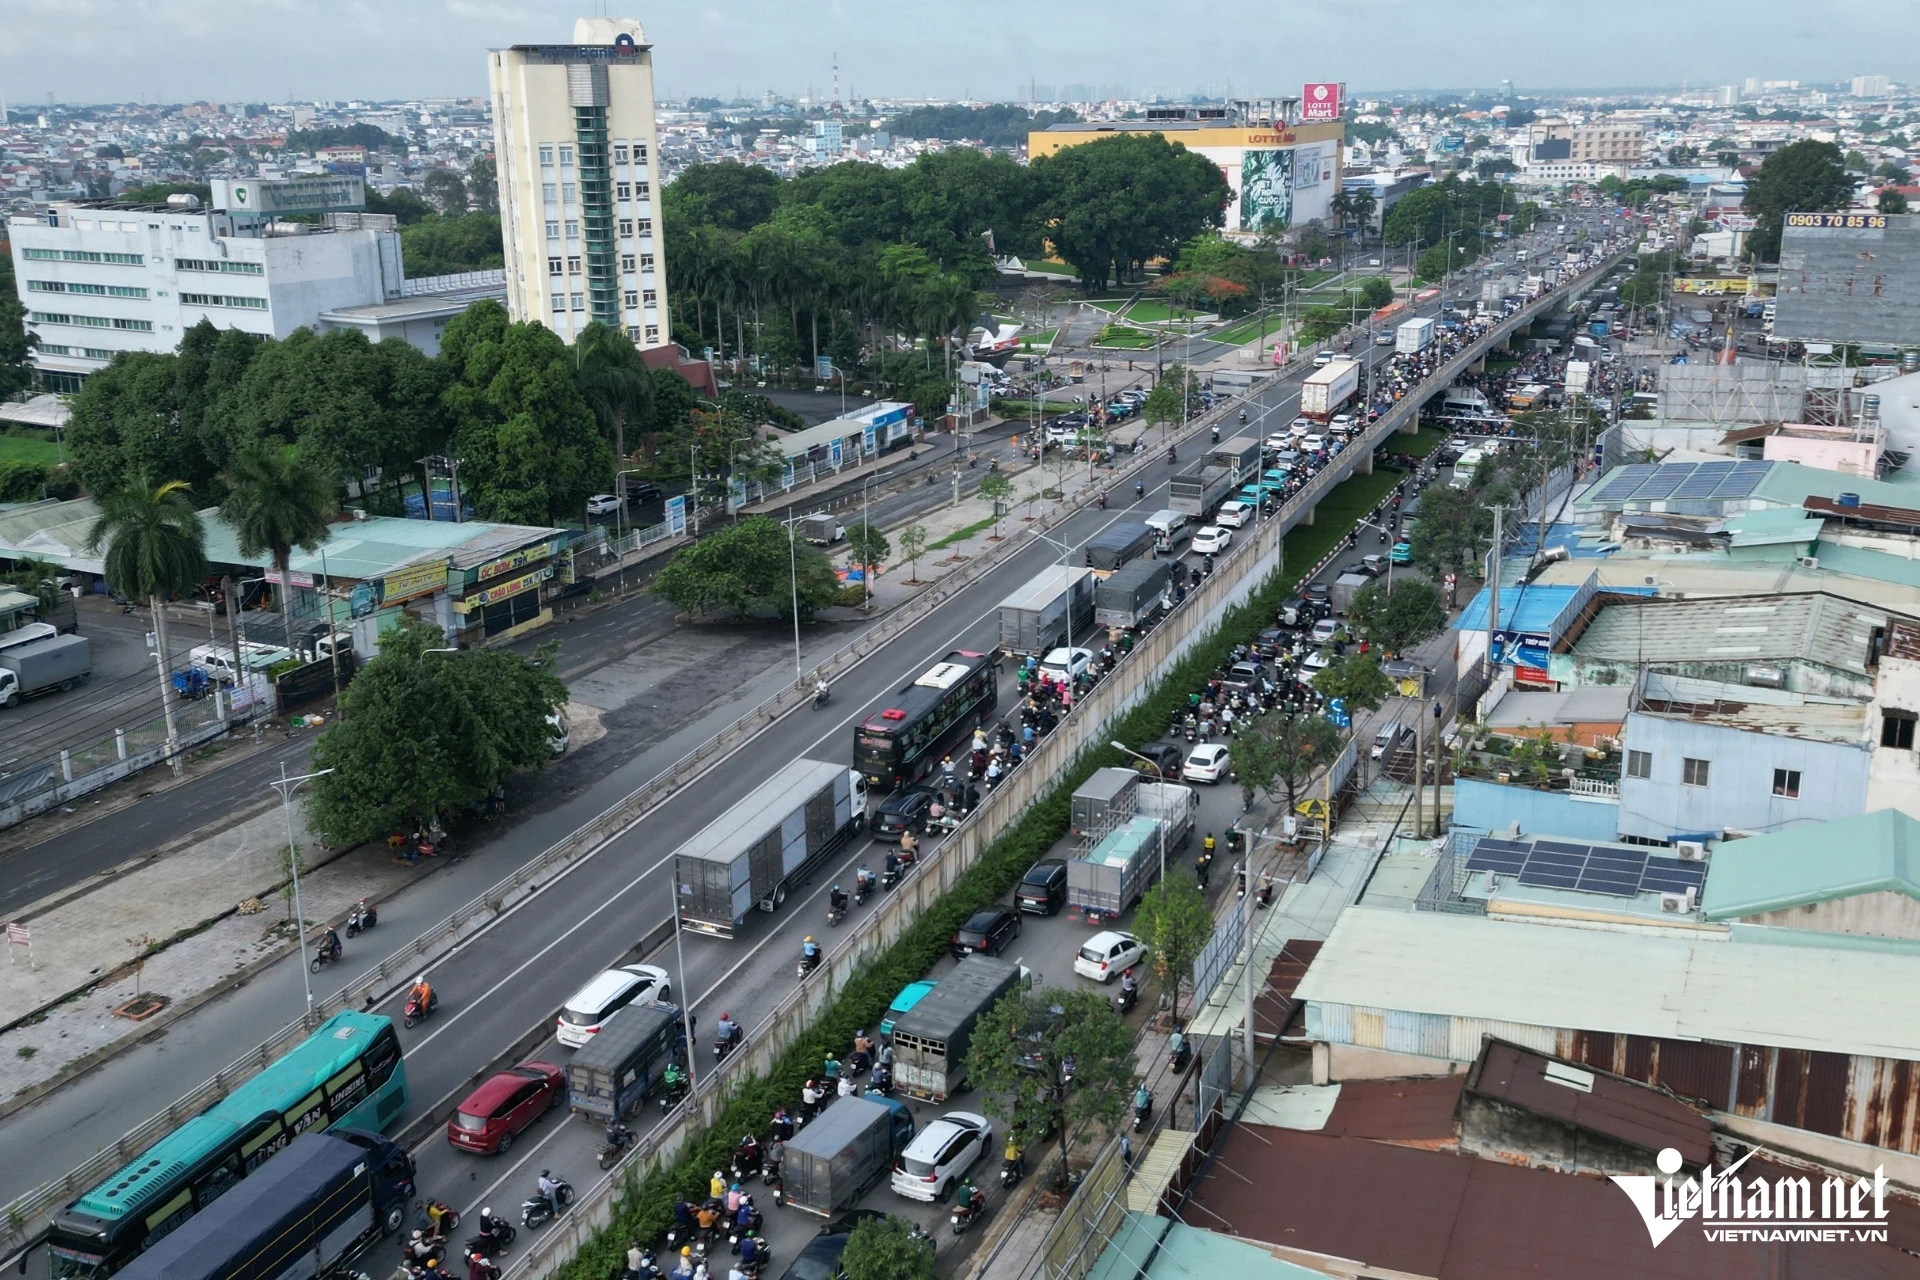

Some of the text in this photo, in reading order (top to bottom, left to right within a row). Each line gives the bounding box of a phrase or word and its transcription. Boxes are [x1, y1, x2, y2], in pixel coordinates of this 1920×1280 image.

[1307, 109, 1333, 117] Mart
[1249, 135, 1282, 143] LOTTE
[270, 189, 351, 207] Vietcombank
[1788, 215, 1886, 228] 0903 70 85 96
